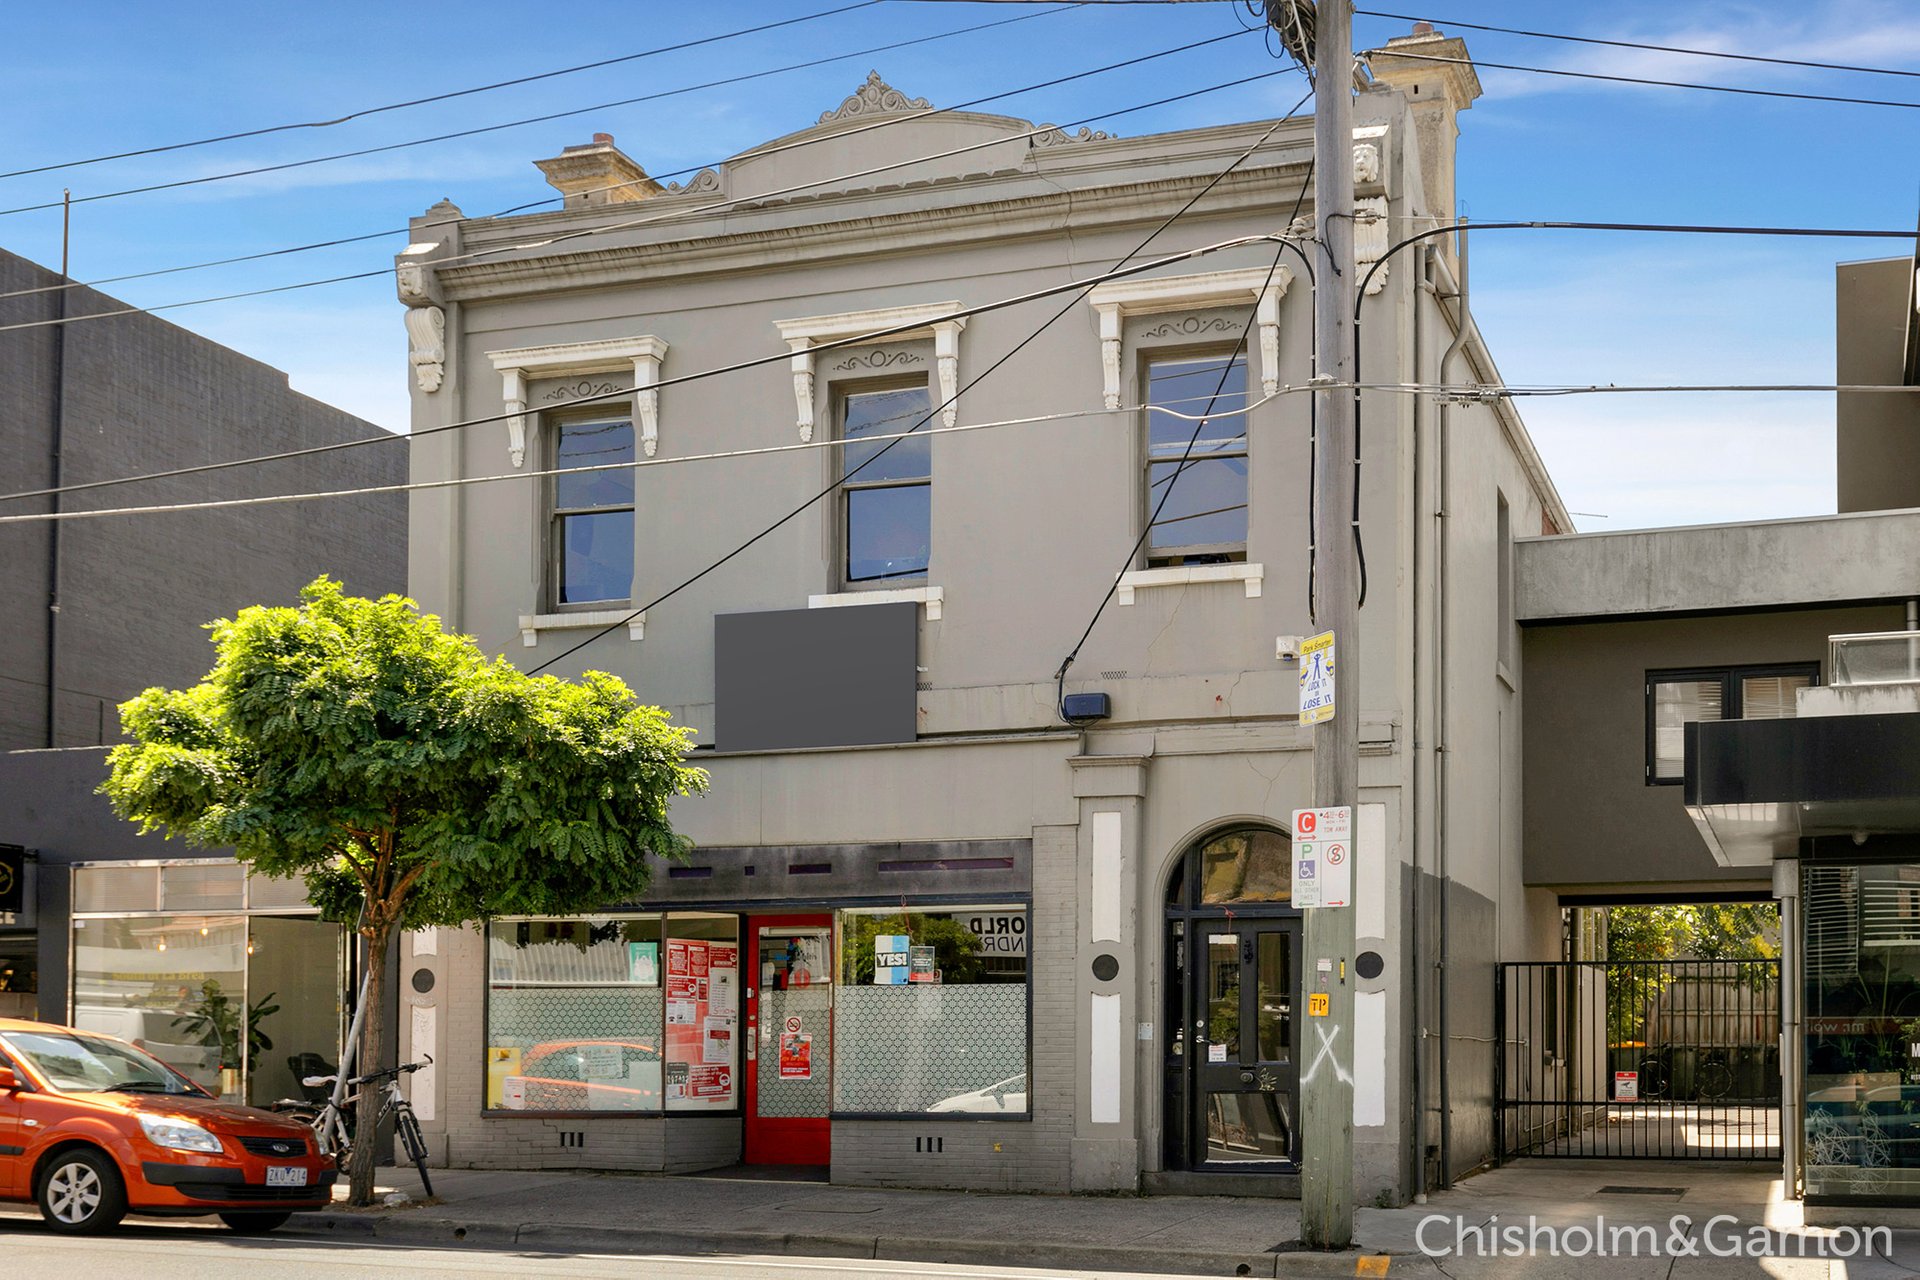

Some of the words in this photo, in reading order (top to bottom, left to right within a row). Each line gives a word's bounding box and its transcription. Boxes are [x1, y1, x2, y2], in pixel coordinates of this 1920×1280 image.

[1303, 643, 1313, 653] Park
[1314, 639, 1331, 650] Smarter
[1307, 680, 1320, 692] LOCK
[1321, 678, 1328, 688] IT
[1303, 697, 1321, 710] LOSE
[1324, 694, 1332, 704] IT
[1301, 813, 1312, 831] C
[1302, 844, 1313, 860] P
[877, 953, 907, 966] YES!
